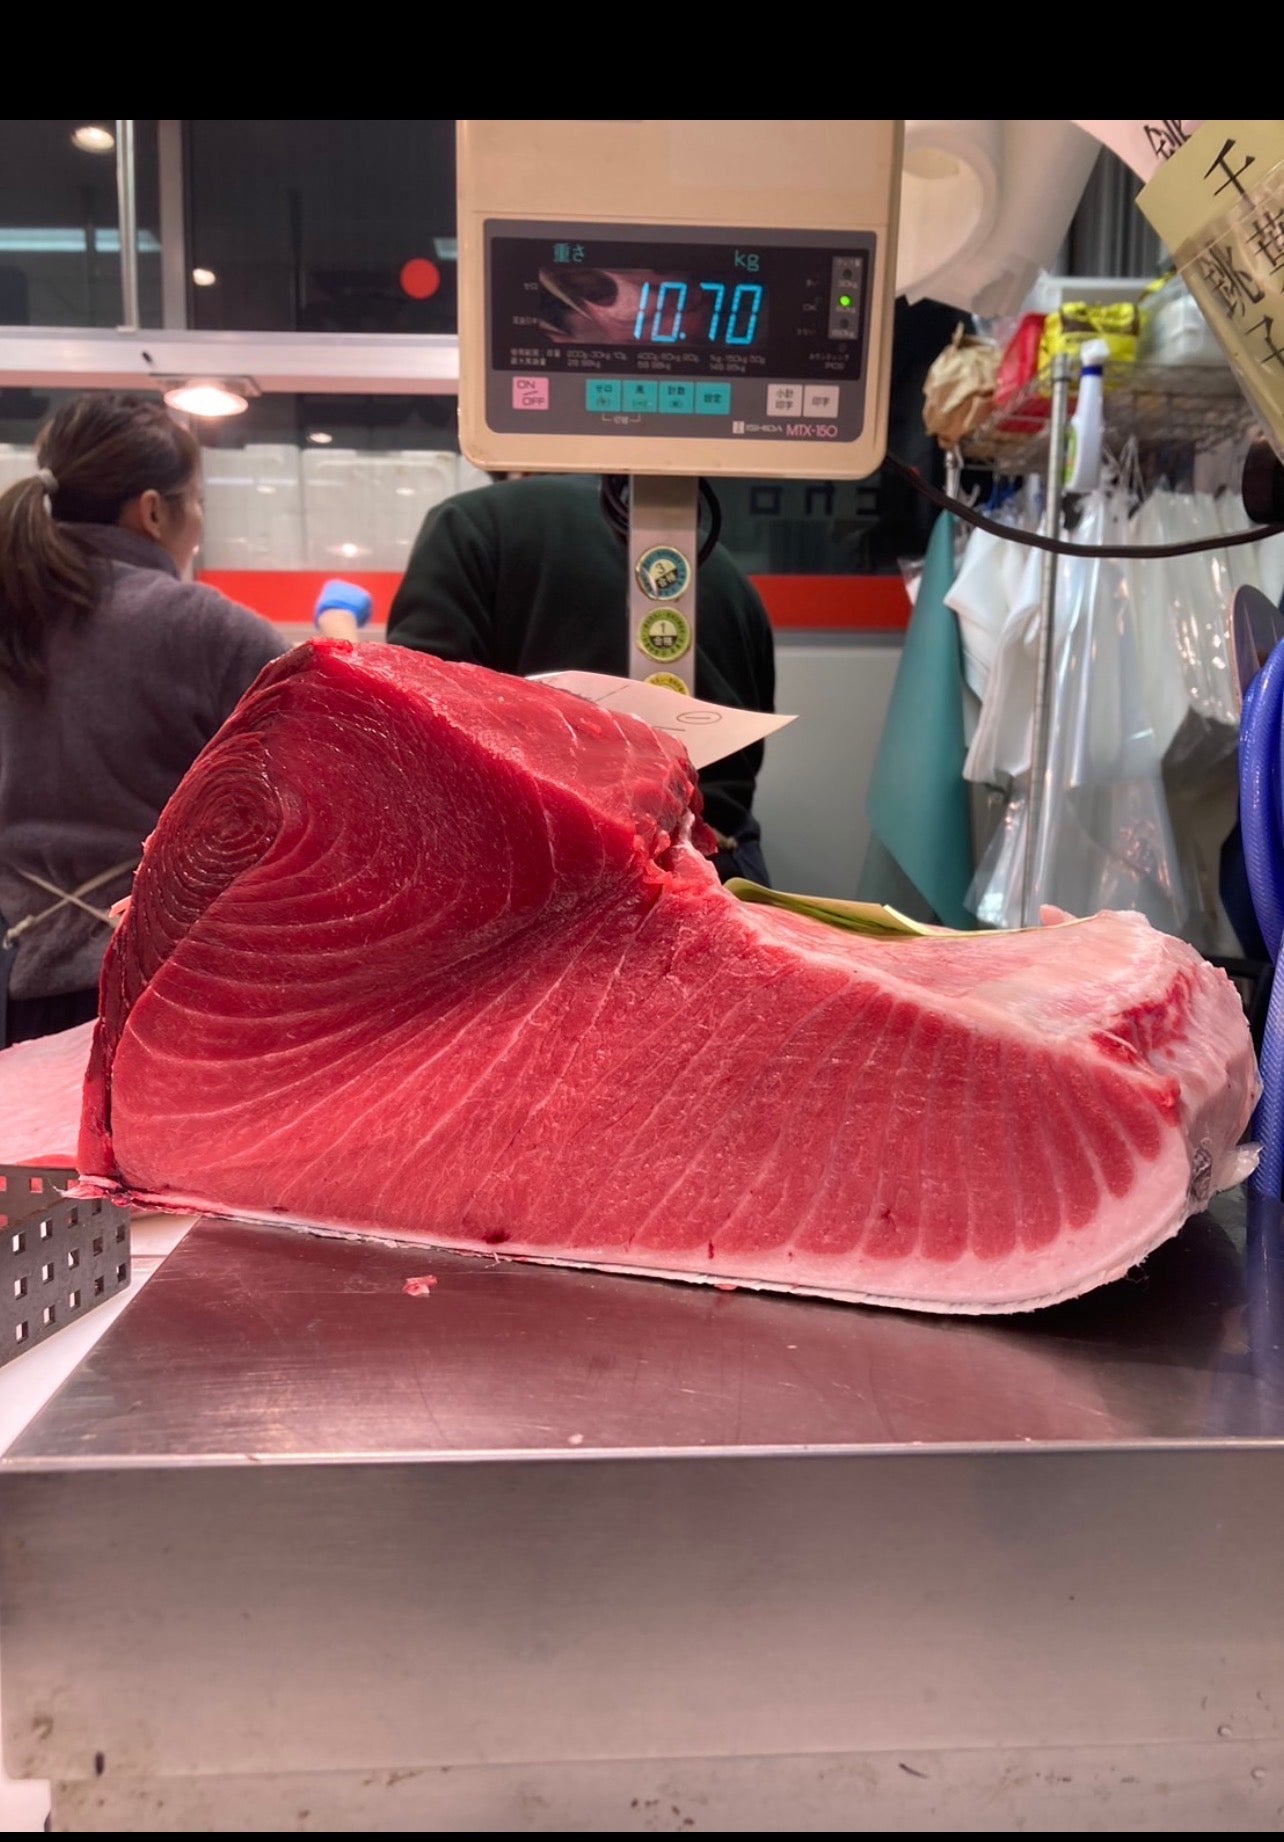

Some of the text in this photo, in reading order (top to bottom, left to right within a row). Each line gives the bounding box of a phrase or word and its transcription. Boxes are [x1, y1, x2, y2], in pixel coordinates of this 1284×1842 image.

[553, 243, 584, 263] 重さ
[734, 250, 760, 272] kg
[633, 281, 763, 345] 10.70
[517, 380, 536, 389] ON
[522, 397, 545, 406] OFF
[786, 424, 839, 438] MTX-150
